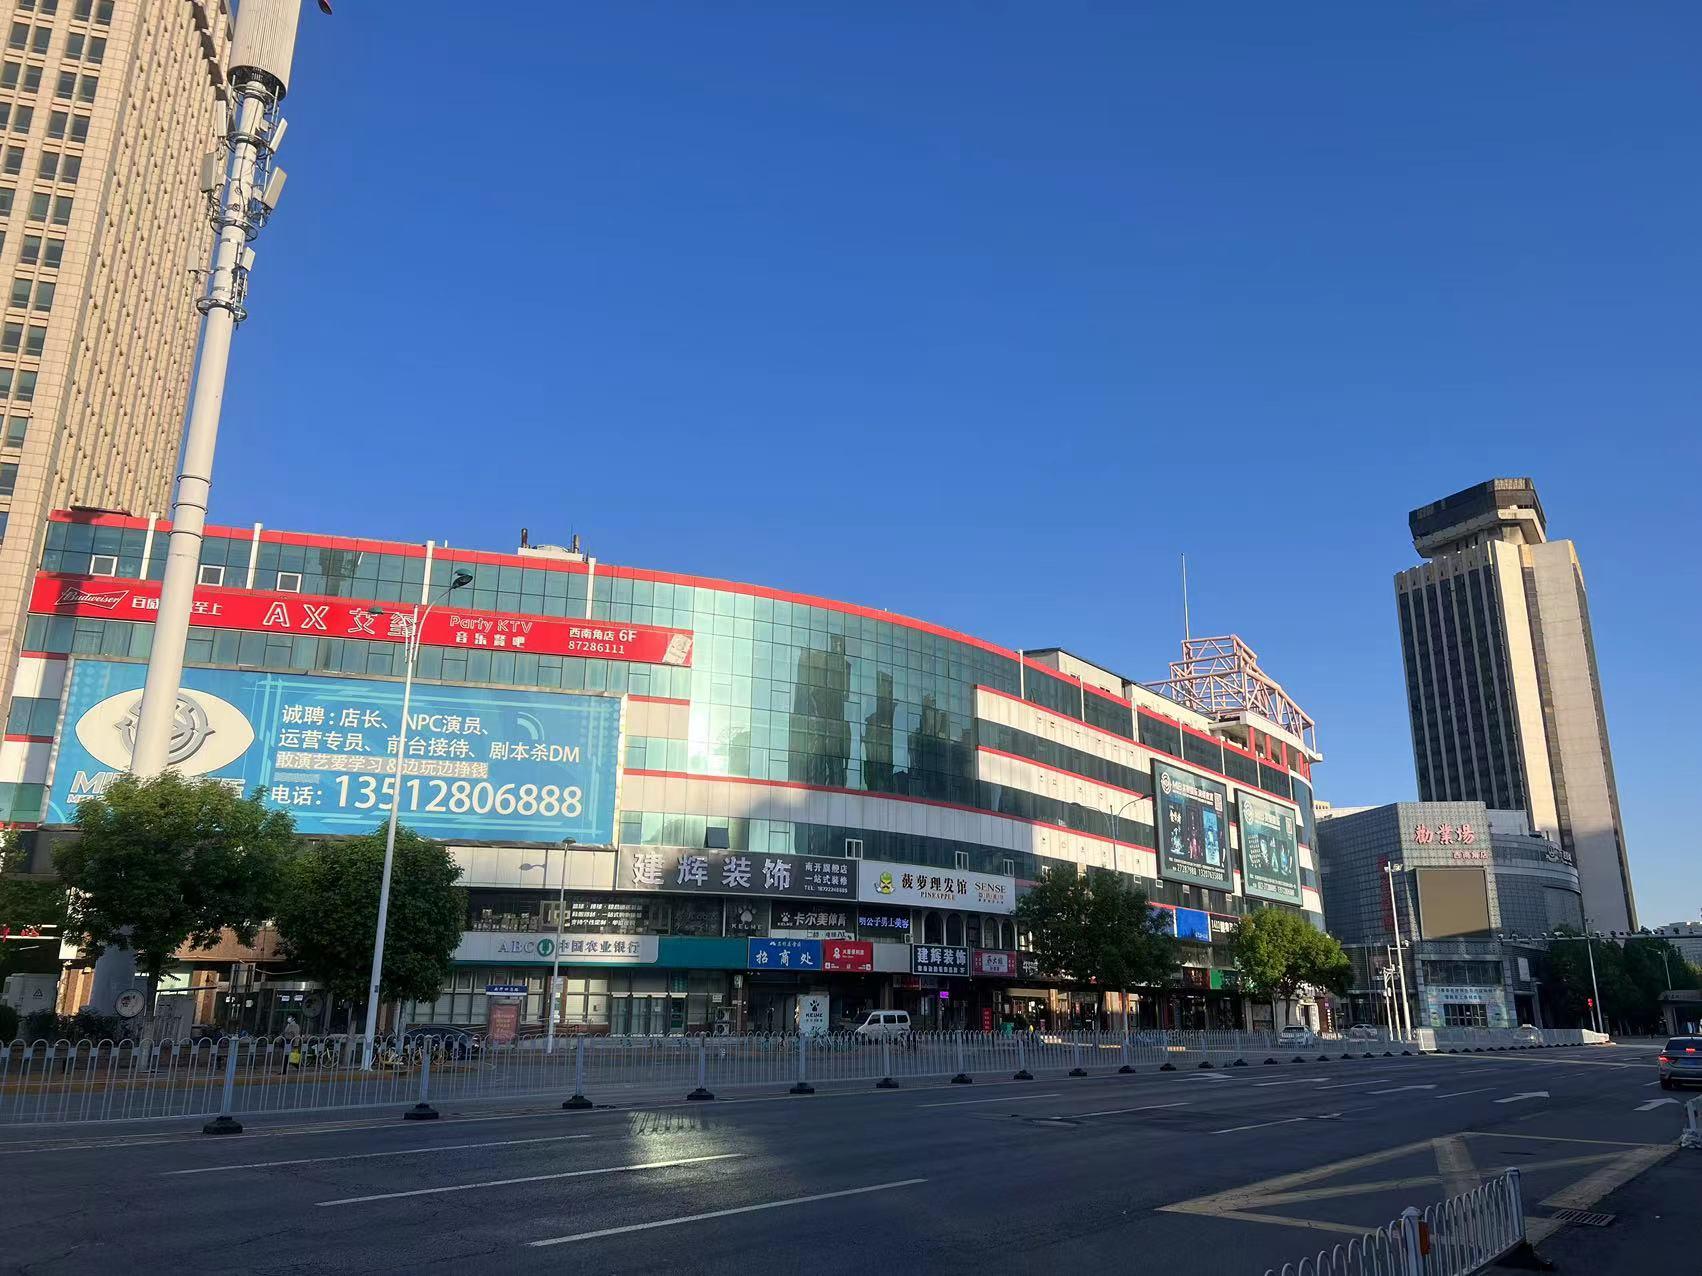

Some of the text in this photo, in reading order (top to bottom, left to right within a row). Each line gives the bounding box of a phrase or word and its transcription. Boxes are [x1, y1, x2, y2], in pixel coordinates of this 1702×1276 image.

[63, 590, 120, 605] Budweiser
[449, 615, 533, 633] Party KTV
[569, 627, 637, 642] 西南角店 6F
[568, 640, 624, 654] 87286111
[335, 775, 583, 817] 13512806888
[632, 852, 792, 891] 建辉装饰
[805, 861, 848, 875] 南开旗舰店
[901, 873, 967, 895] 菠萝理发馆
[974, 881, 1006, 894] SENSE
[920, 891, 956, 901] PINEAPPLE
[794, 912, 847, 927] 卡尔美体育
[498, 940, 534, 954] ABC
[559, 939, 640, 954] 中国农业银行
[756, 949, 814, 966] 招商处
[917, 947, 966, 965] 建辉装饰
